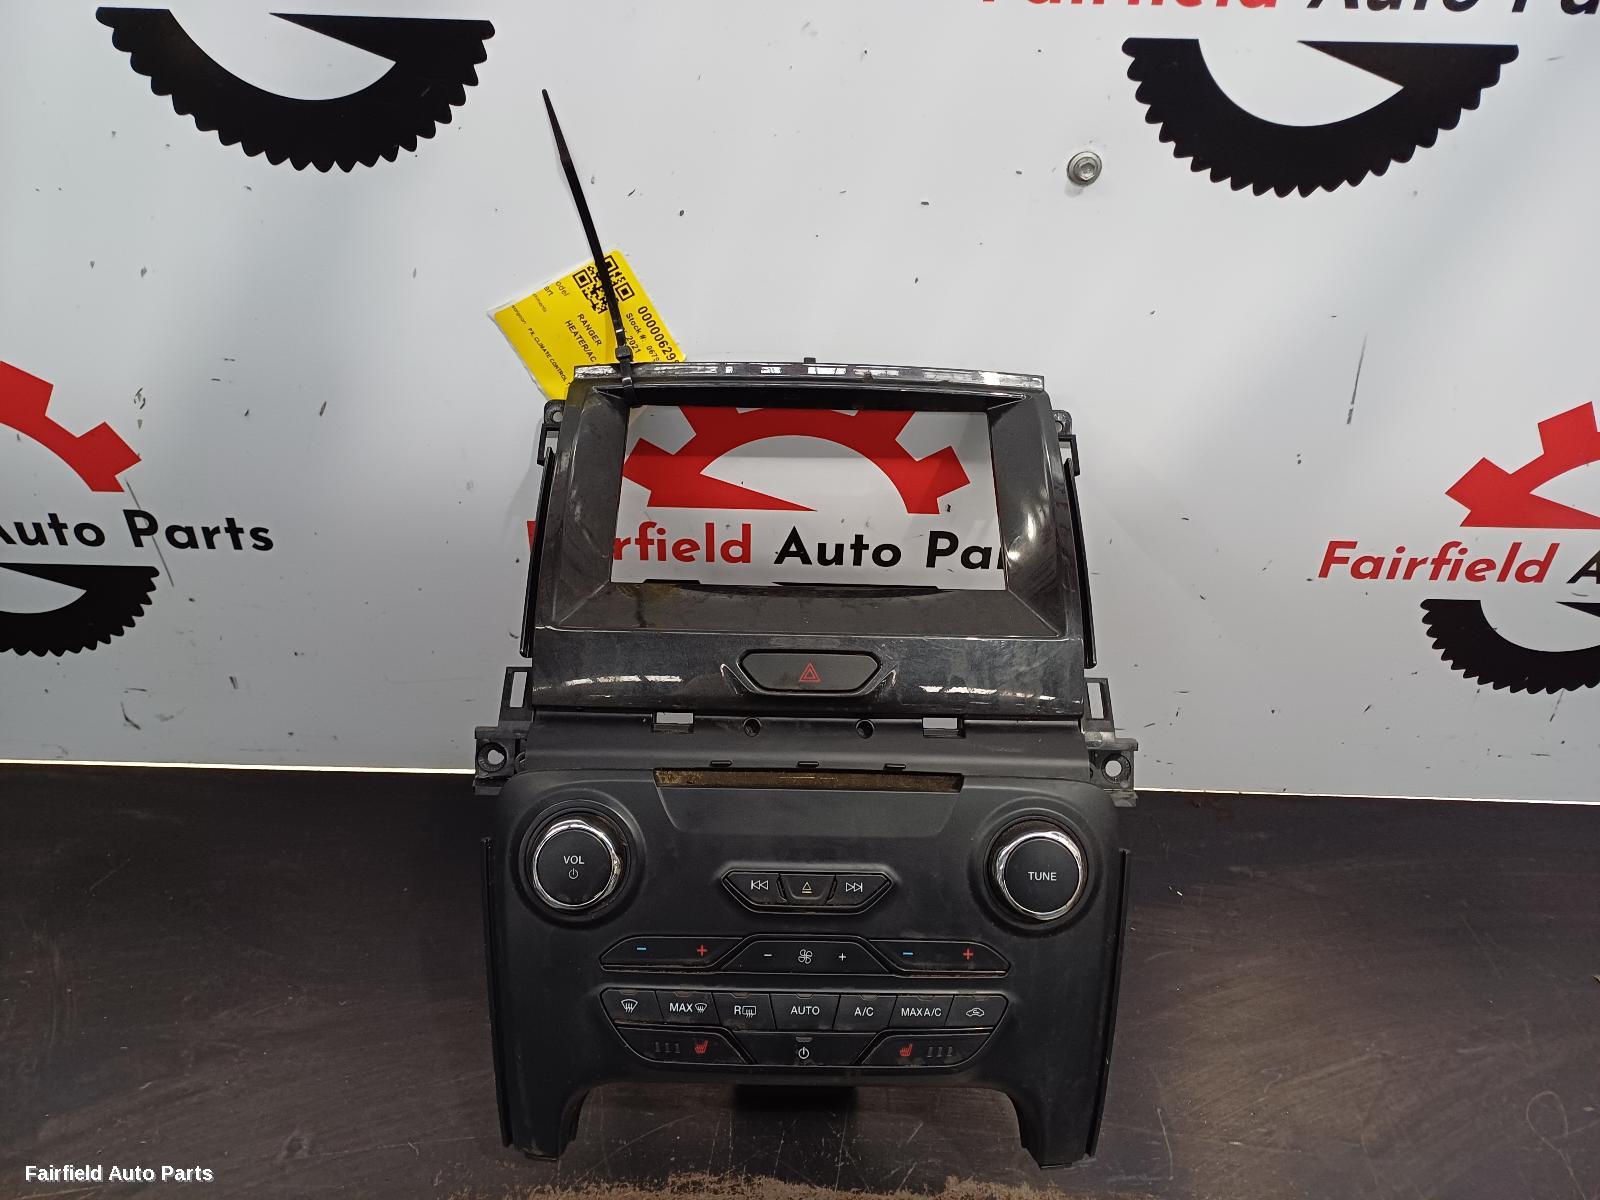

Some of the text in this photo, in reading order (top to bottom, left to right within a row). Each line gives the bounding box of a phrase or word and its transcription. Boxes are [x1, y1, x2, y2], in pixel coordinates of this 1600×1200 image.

[577, 313, 602, 346] RANGER
[625, 312, 642, 334] Stock
[565, 320, 597, 362] HEATER/AC
[534, 336, 552, 359] CLIMATE
[549, 358, 567, 382] CONTROL
[123, 509, 274, 551] Parts
[773, 525, 901, 567] Auto
[1317, 540, 1560, 583] Fairfield
[563, 855, 585, 865] VOL
[1028, 871, 1057, 881] TUNE
[669, 1002, 693, 1013] MAX
[790, 1005, 820, 1016] AUTO
[854, 1006, 874, 1017] A/C
